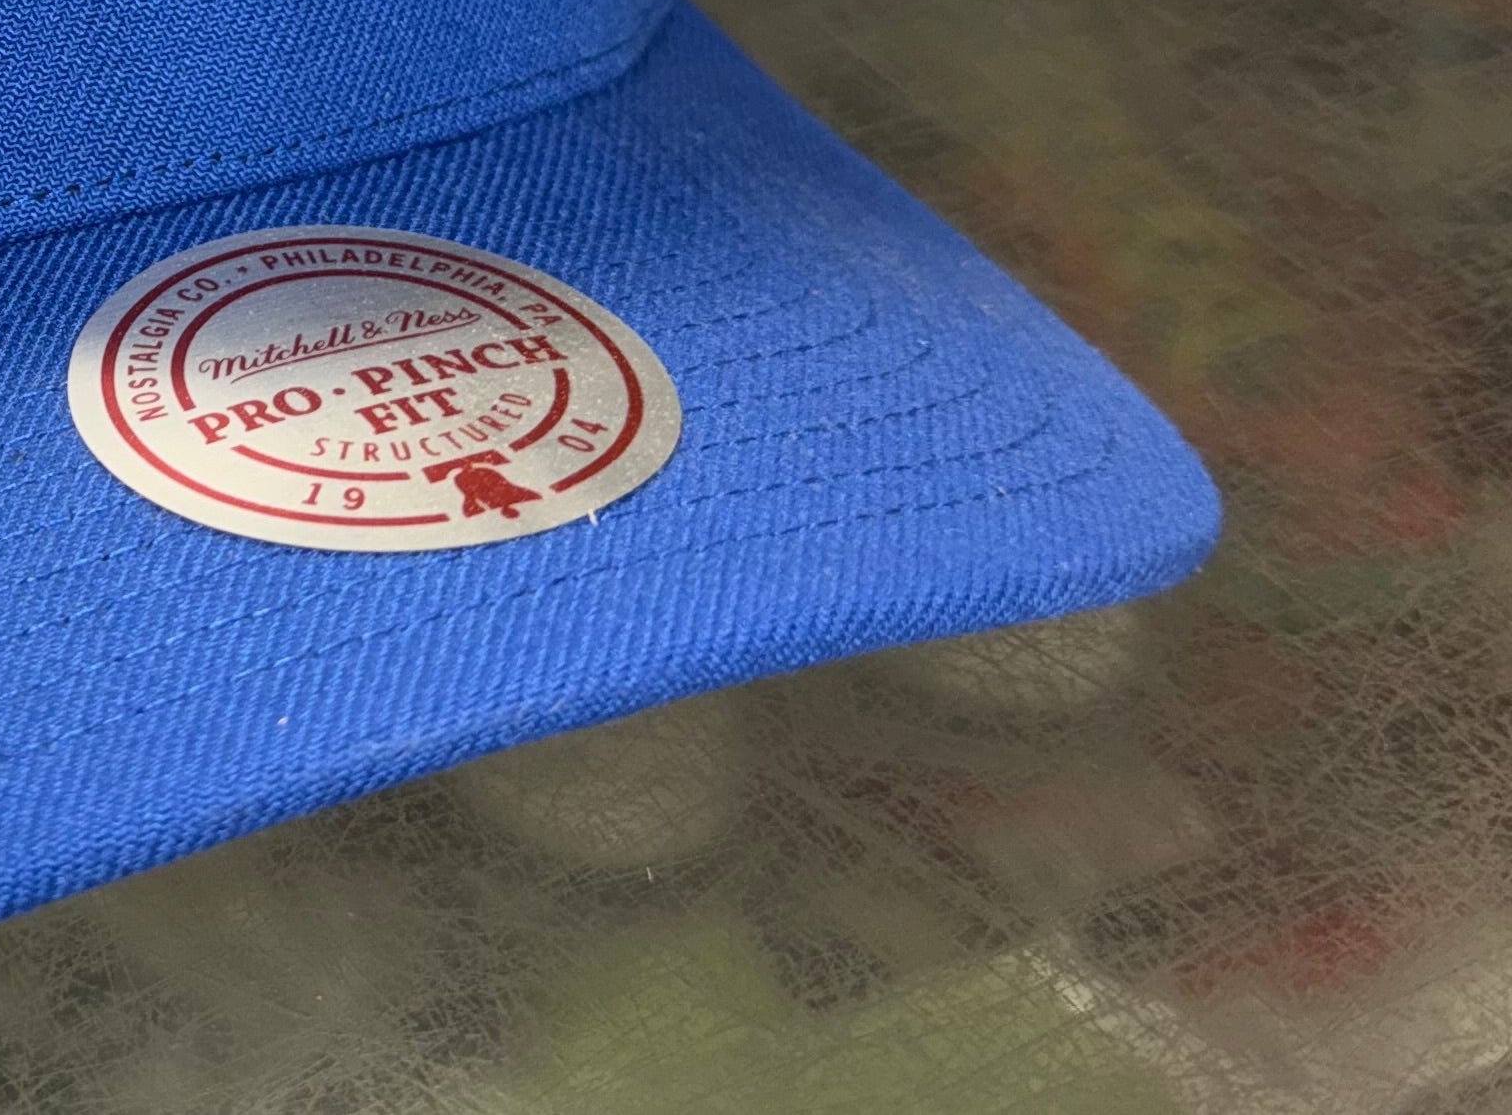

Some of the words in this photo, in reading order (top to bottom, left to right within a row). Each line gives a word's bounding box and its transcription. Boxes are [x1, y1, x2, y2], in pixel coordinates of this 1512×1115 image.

[128, 308, 185, 421] NOSTALGIA
[177, 278, 231, 302] CO.
[260, 248, 507, 301] PHILADELPHIA,
[519, 302, 563, 328] PA
[198, 323, 356, 381] Mitchell
[361, 320, 384, 339] &
[385, 307, 478, 333] Ness
[187, 387, 323, 444] PRO
[351, 335, 568, 396] PINCH
[354, 387, 464, 435] FIT
[309, 393, 533, 463] STRUCTURED
